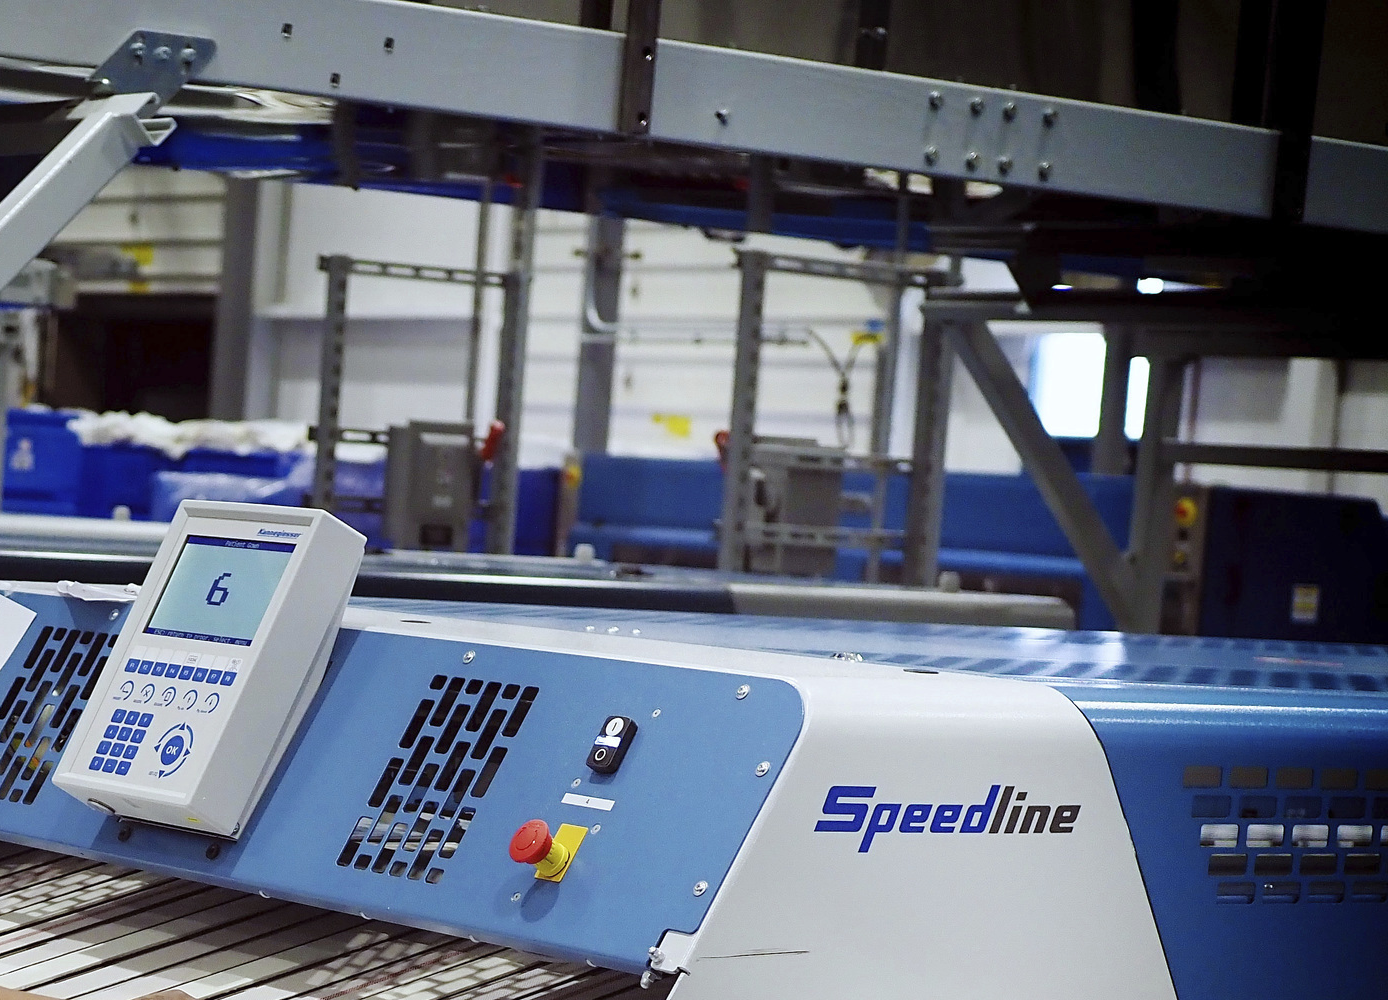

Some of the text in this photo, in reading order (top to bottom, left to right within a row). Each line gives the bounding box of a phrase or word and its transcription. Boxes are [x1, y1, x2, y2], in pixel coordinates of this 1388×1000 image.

[205, 572, 232, 606] 6
[165, 745, 179, 756] OK
[814, 784, 1081, 853] Speedline
